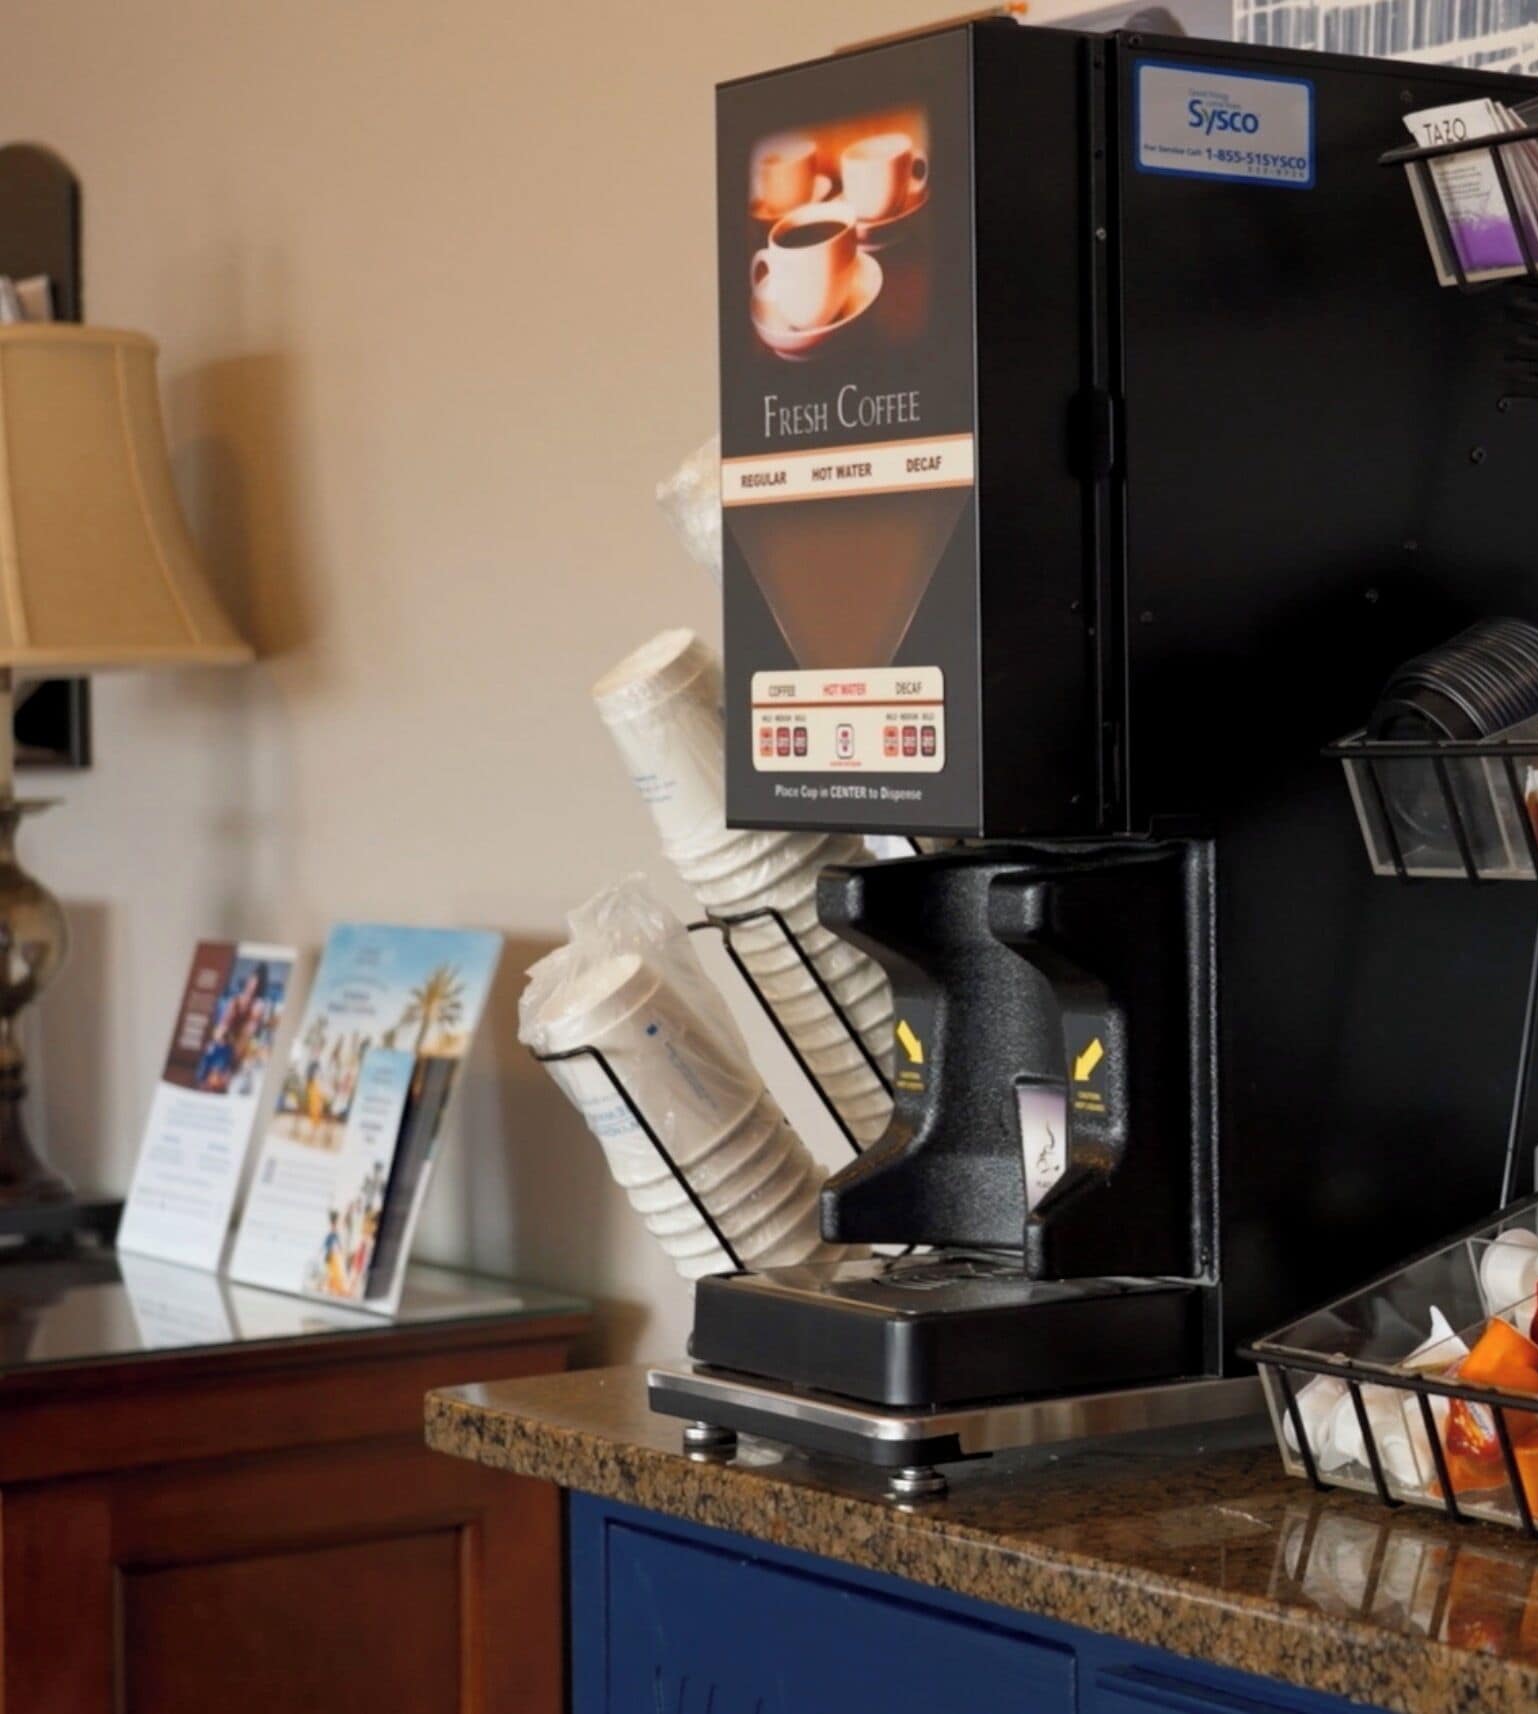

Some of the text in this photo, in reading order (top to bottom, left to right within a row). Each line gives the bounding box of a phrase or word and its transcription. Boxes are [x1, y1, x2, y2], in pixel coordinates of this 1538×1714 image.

[1422, 118, 1467, 145] TAZO
[741, 455, 942, 489] REGULAR HOT WATER DECAF
[768, 683, 796, 697] COFFEE
[895, 681, 923, 695] DECAF
[775, 784, 799, 798] Place
[801, 785, 818, 801] Cup
[830, 786, 867, 799] CENTER
[880, 786, 922, 803] Dispense
